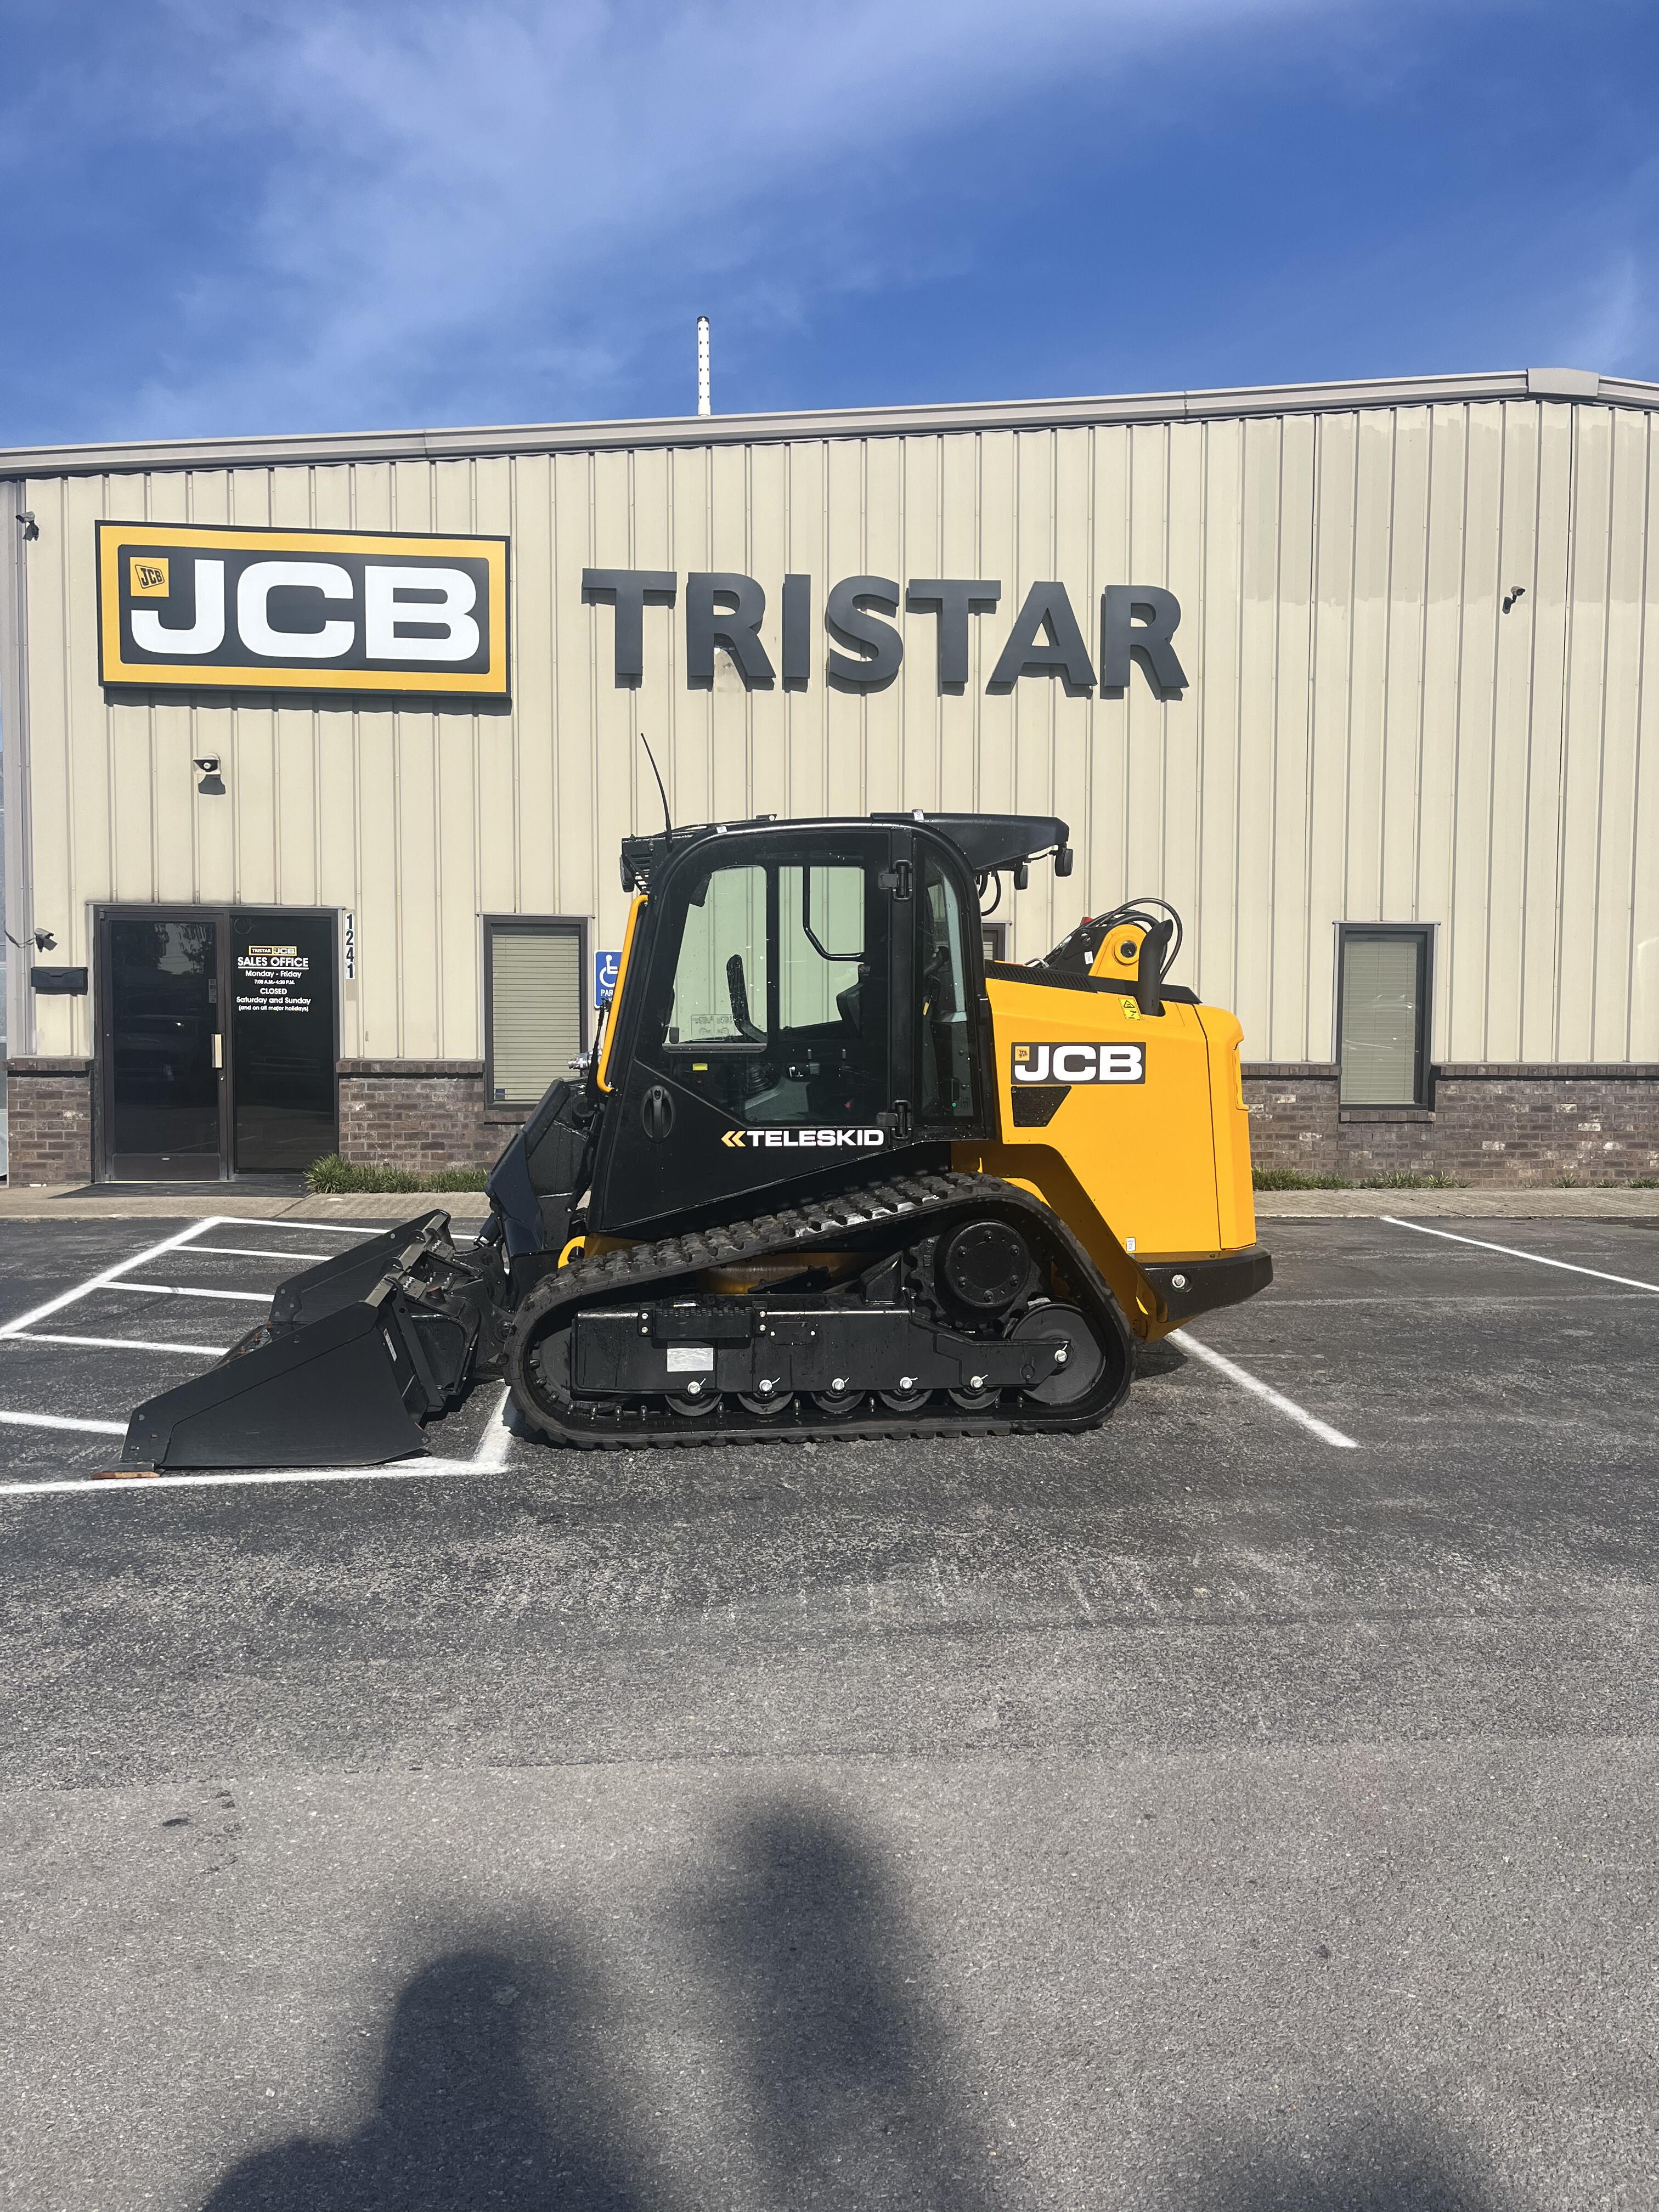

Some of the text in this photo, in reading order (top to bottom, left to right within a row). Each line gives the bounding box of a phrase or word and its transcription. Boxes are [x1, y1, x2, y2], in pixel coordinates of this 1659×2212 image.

[140, 567, 162, 586] JCB
[131, 558, 480, 662] JCB
[582, 568, 1189, 690] TRISTAR
[346, 913, 354, 979] 1241
[237, 956, 309, 967] SALES OFFICE
[285, 997, 311, 1005] Sunday
[600, 989, 613, 997] PAR
[1014, 1045, 1143, 1081] JCB
[747, 1130, 884, 1147] TELESKID
